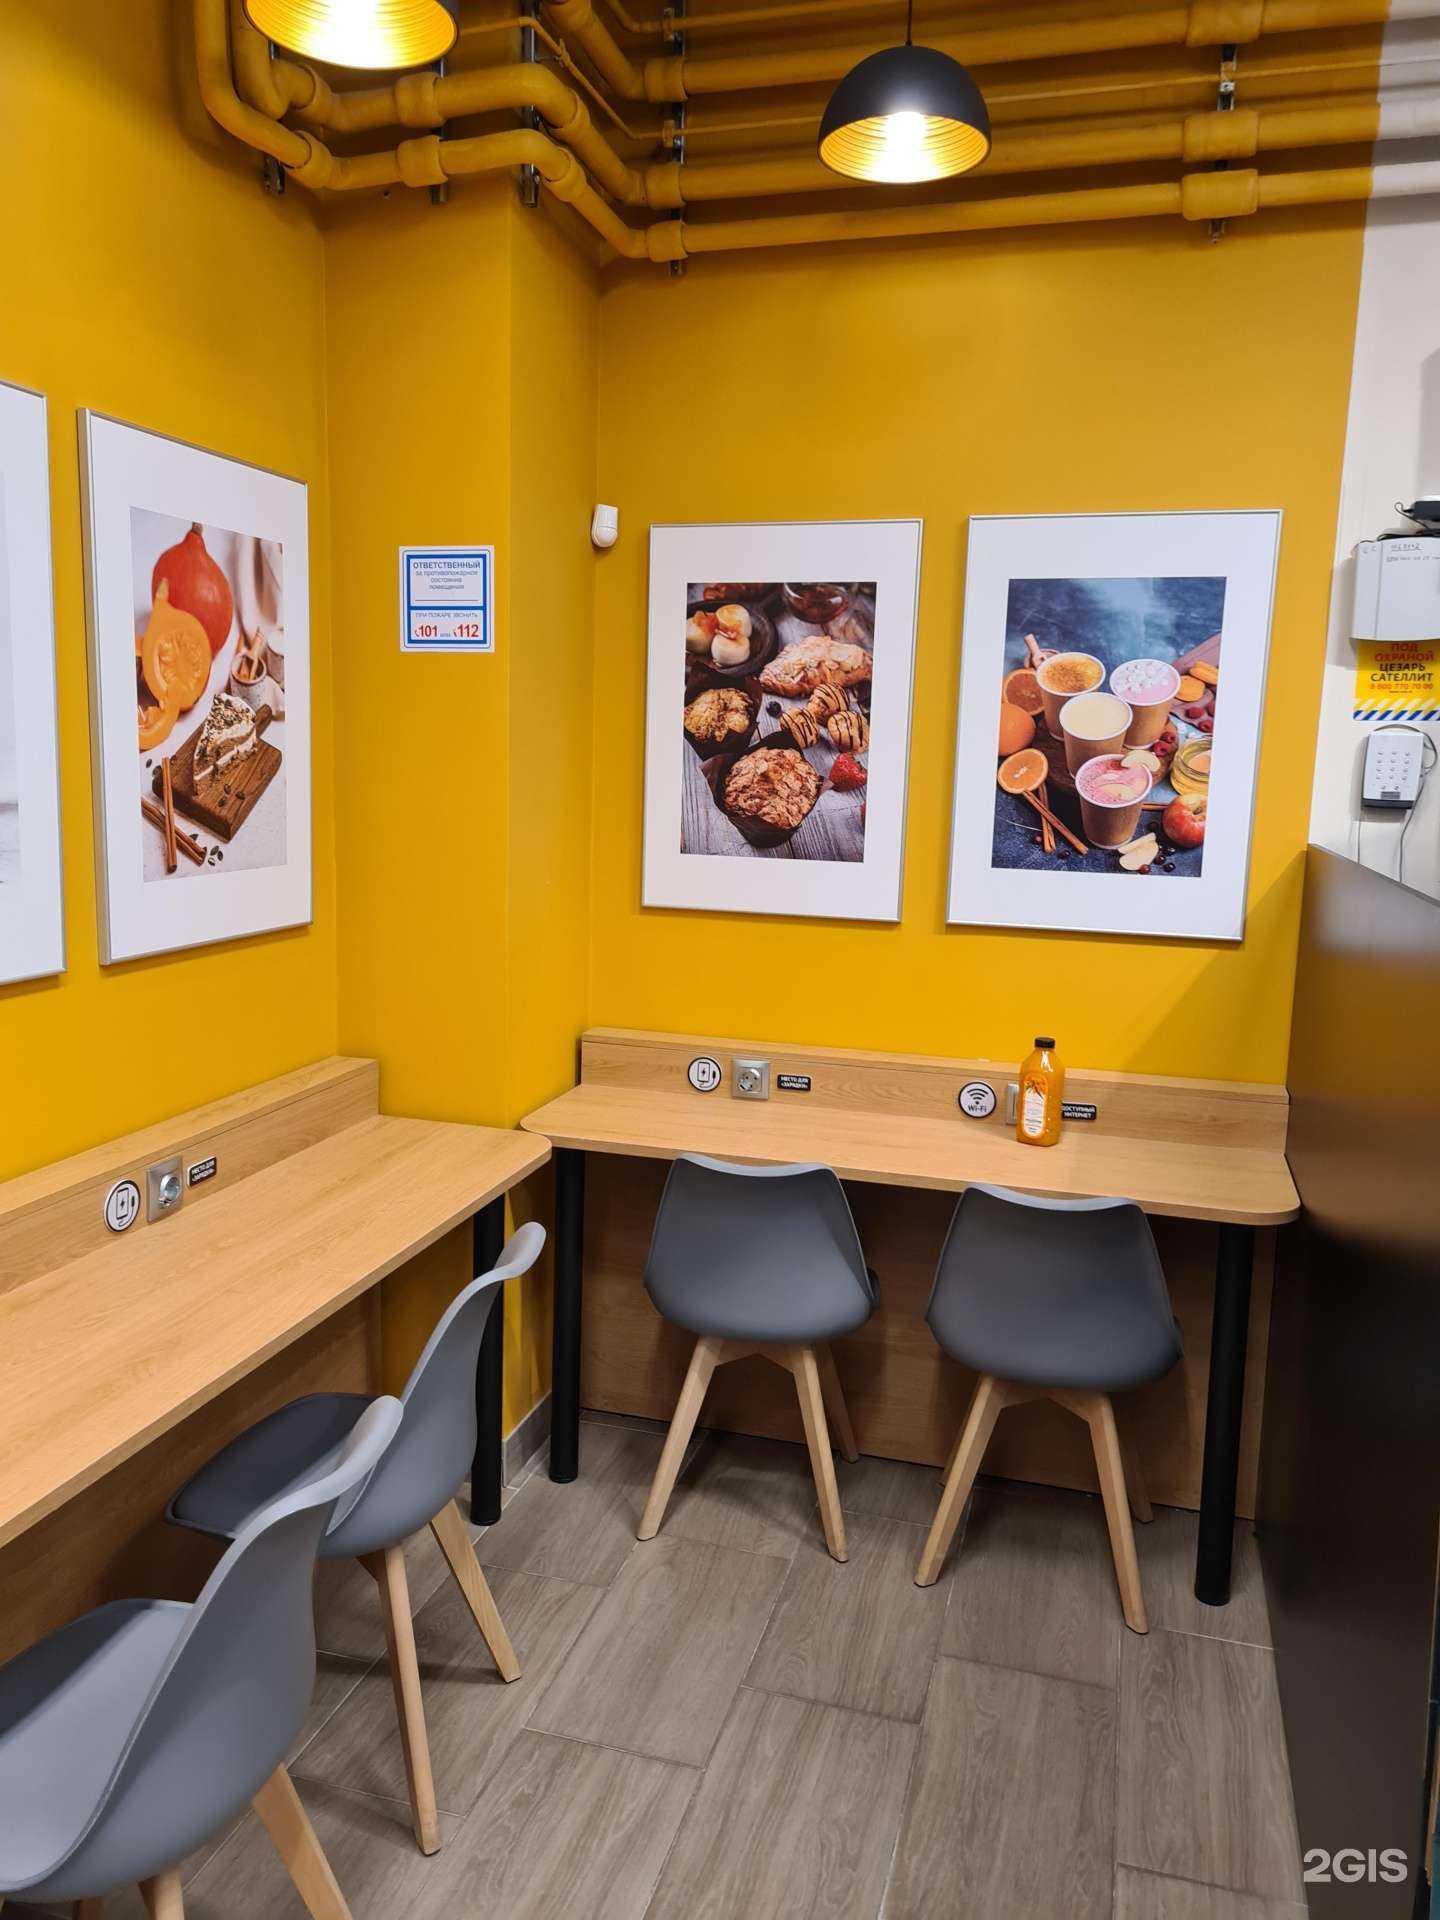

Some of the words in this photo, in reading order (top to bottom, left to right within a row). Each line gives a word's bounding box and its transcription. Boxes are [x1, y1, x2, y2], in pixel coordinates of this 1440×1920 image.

[413, 561, 481, 569] ОТВЕТСТВЕННЫЙ
[418, 624, 438, 637] 101
[457, 623, 479, 638] 112
[1391, 643, 1418, 652] ПОД
[1375, 650, 1434, 661] ОХРАНОЙ
[1379, 663, 1426, 673] ЦЕЗАРЬ
[1370, 672, 1434, 682] САТЕЛЛИТ
[967, 1104, 987, 1112] Wi-Fi
